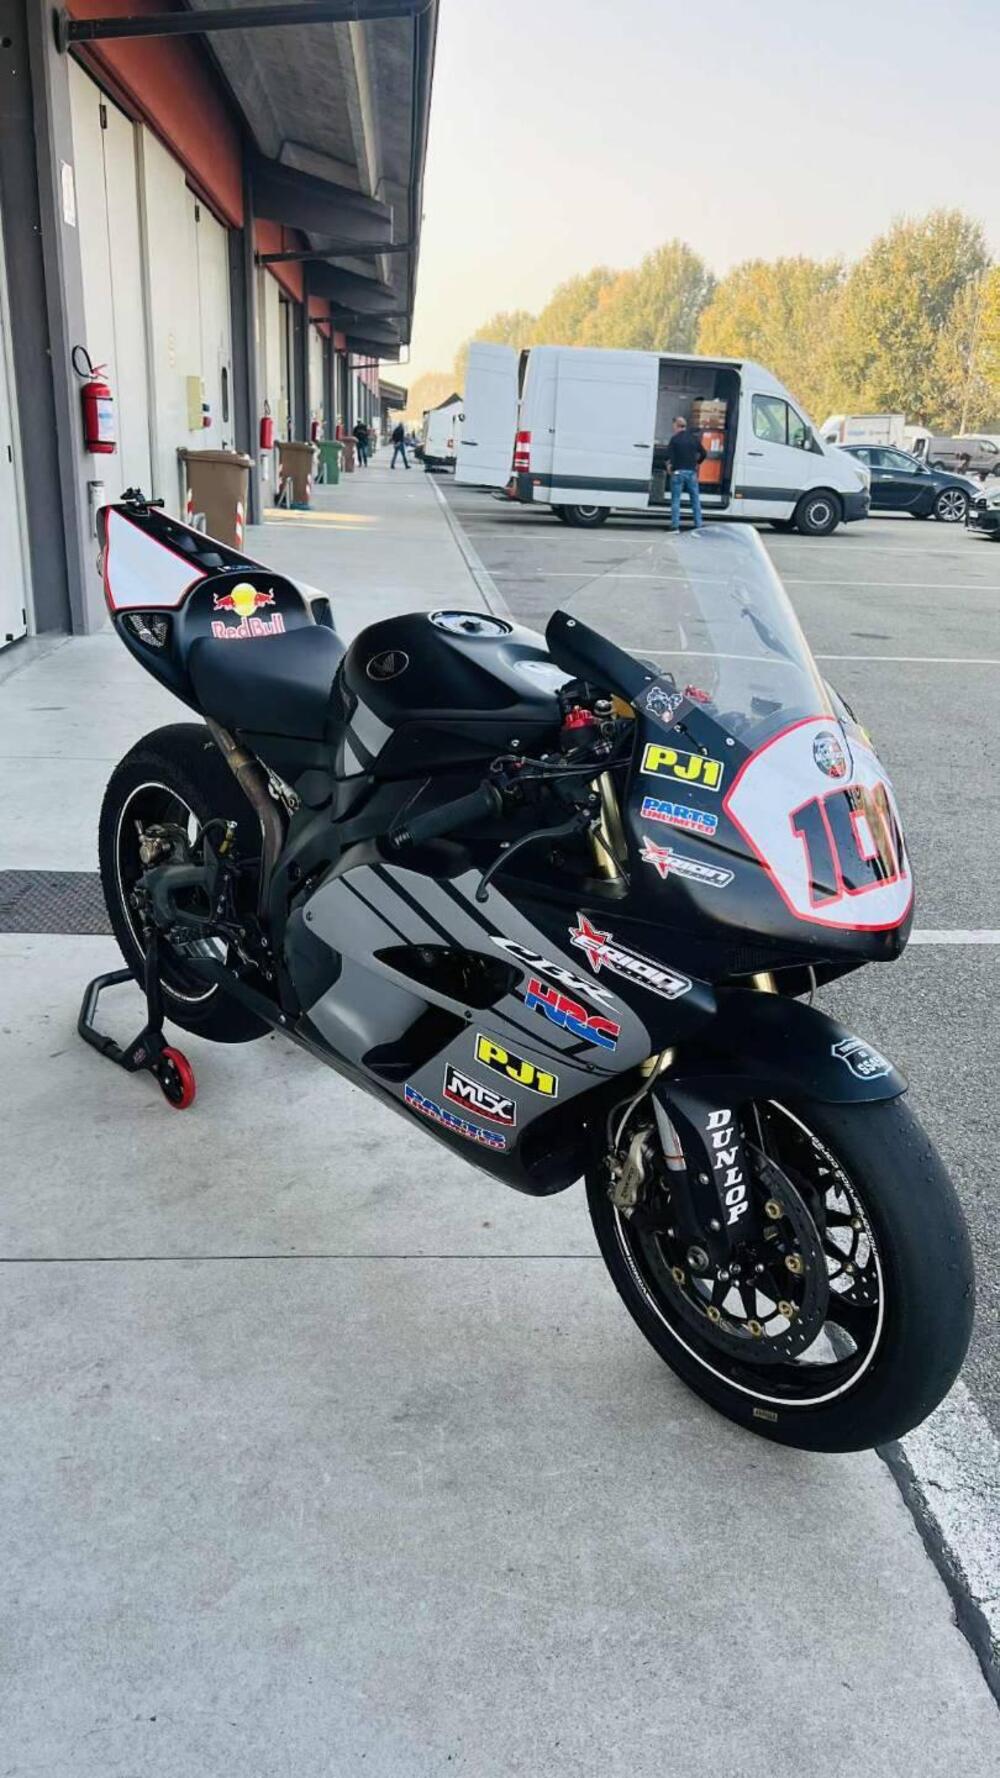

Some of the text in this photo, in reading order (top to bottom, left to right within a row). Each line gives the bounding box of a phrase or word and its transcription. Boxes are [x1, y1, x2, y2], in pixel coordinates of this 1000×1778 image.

[211, 613, 286, 639] Red Bull
[645, 747, 721, 787] PJ1
[641, 808, 715, 835] UNLIMITED
[642, 796, 718, 827] PARTS
[490, 936, 622, 1014] CBR
[573, 934, 688, 991] ERION
[525, 979, 620, 1052] HRC
[447, 1069, 514, 1120] MTX
[477, 1037, 556, 1095] PJ1
[404, 1084, 505, 1142] PARTS
[707, 1109, 749, 1226] DUNLOP
